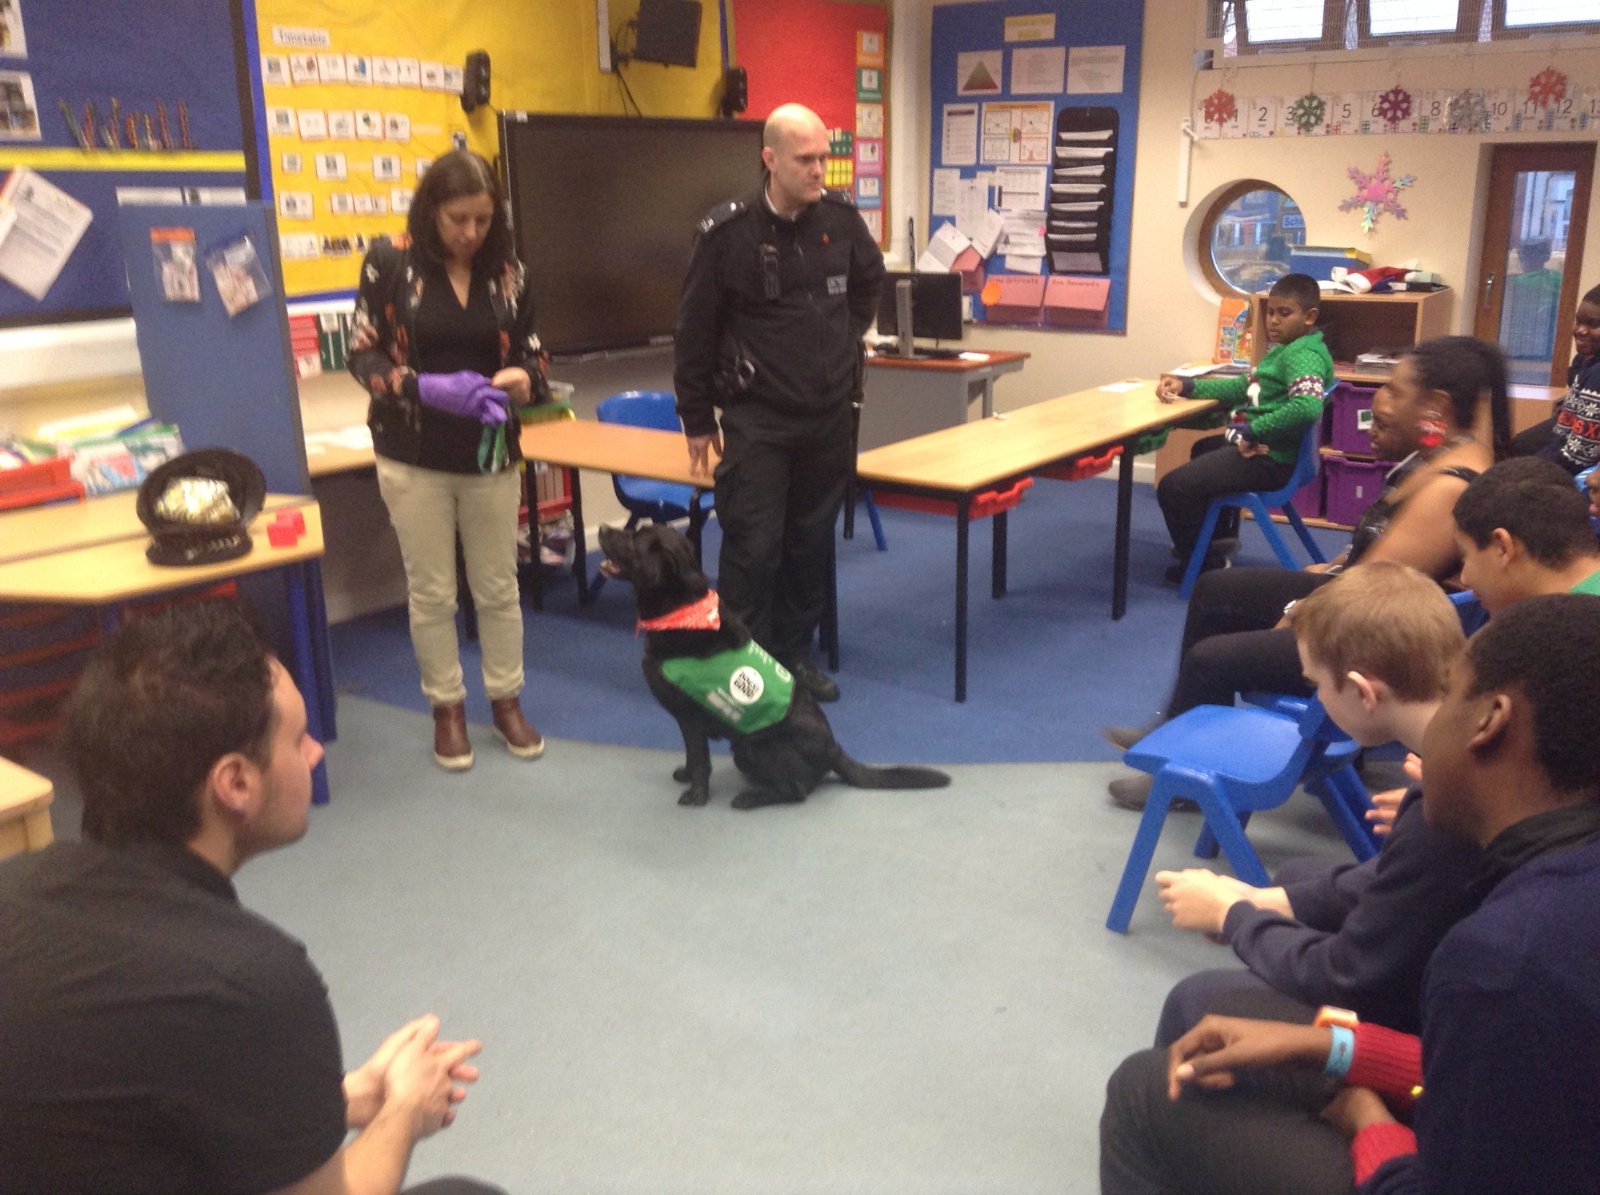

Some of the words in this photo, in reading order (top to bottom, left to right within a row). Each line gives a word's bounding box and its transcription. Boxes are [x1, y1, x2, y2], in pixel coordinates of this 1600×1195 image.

[1258, 106, 1268, 122] 2
[1286, 106, 1295, 121] 3
[1342, 103, 1352, 118] 5
[1430, 101, 1441, 117] 8
[1491, 101, 1508, 116] 10
[1522, 99, 1538, 115] 11
[1556, 98, 1573, 114] 12
